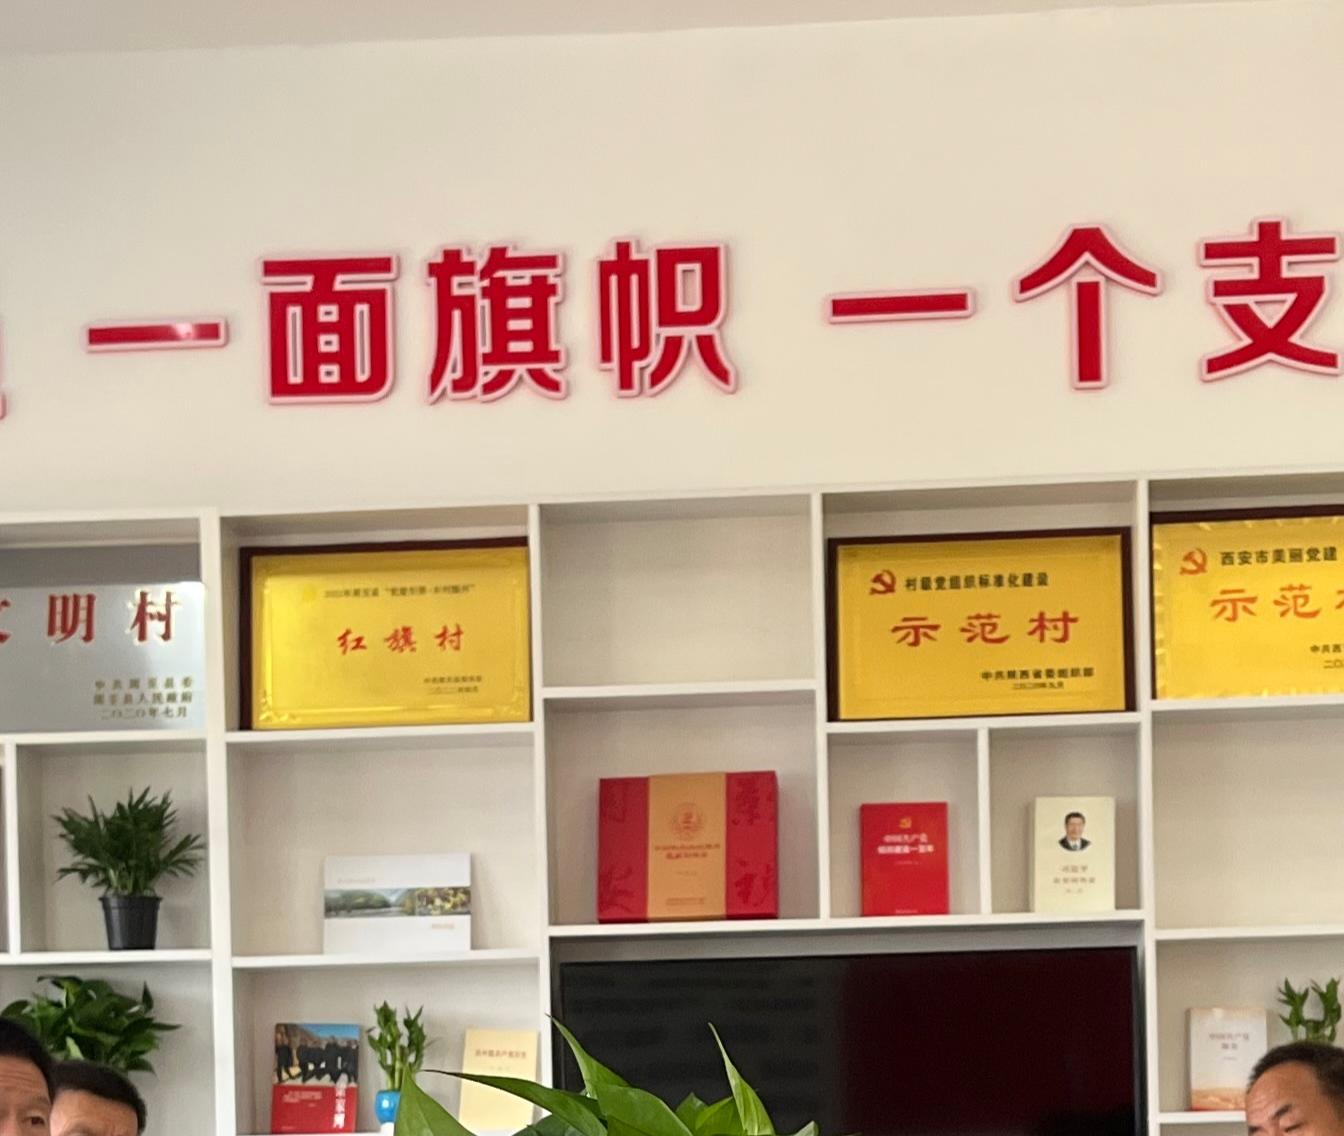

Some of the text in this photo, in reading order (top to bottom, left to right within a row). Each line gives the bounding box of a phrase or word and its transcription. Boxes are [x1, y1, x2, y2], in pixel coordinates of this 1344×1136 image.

[84, 237, 739, 408] 一面旗帜
[1220, 546, 1338, 566] 西安市美丽党建
[336, 623, 464, 655] 红旗村
[890, 610, 1080, 648] 示范村
